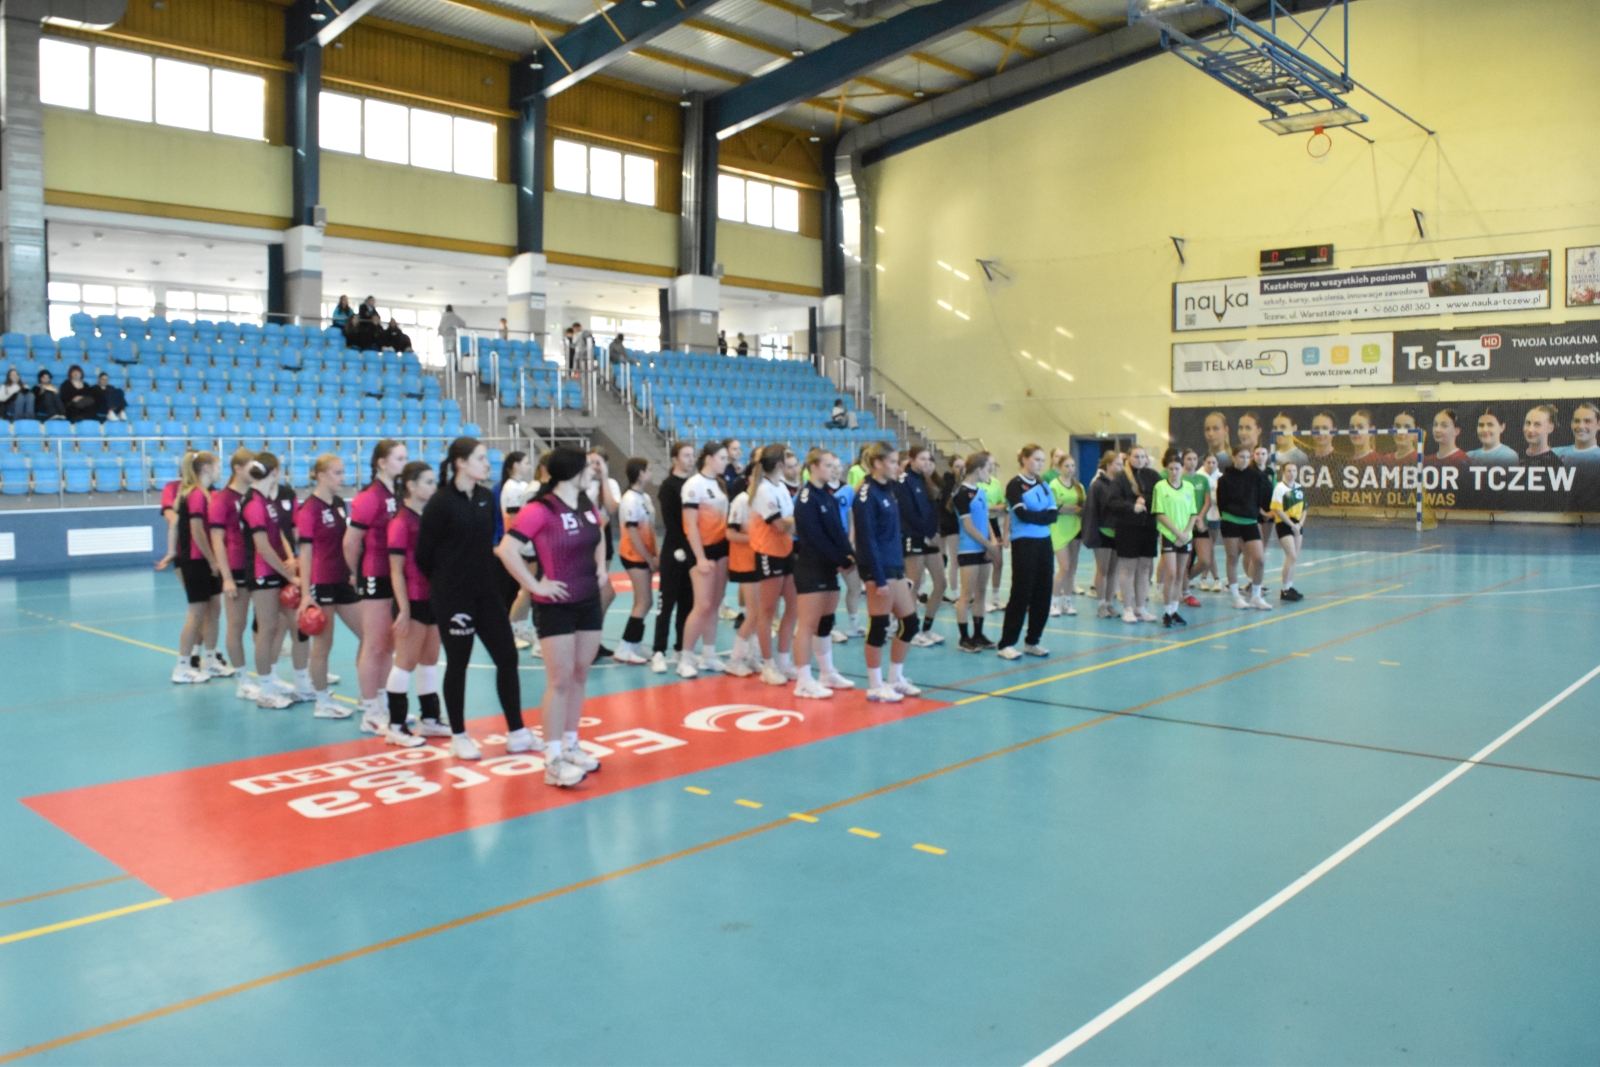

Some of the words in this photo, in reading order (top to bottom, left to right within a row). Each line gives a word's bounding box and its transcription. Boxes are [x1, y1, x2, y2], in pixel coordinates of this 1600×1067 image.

[1263, 281, 1309, 291] Kształcimy
[1321, 275, 1369, 287] wszystkich
[1370, 271, 1417, 284] poziomach
[1384, 288, 1424, 296] zawodowe
[1184, 284, 1249, 321] nauka
[1300, 309, 1352, 318] Warsztatowa
[1383, 305, 1399, 313] 660
[1446, 295, 1541, 309] www.nauka-tczew.pl
[1484, 338, 1498, 346] HD
[1512, 337, 1547, 348] TWOJA
[1549, 335, 1598, 346] LOKALNA
[1204, 359, 1253, 371] TELKAB
[1305, 366, 1378, 376] www.tczew.net.pl
[1343, 465, 1459, 490] SAMBOR
[1469, 466, 1577, 491] TCZEW
[1332, 491, 1382, 504] GRAMY
[1387, 492, 1417, 505] DLA
[560, 512, 579, 530] 15
